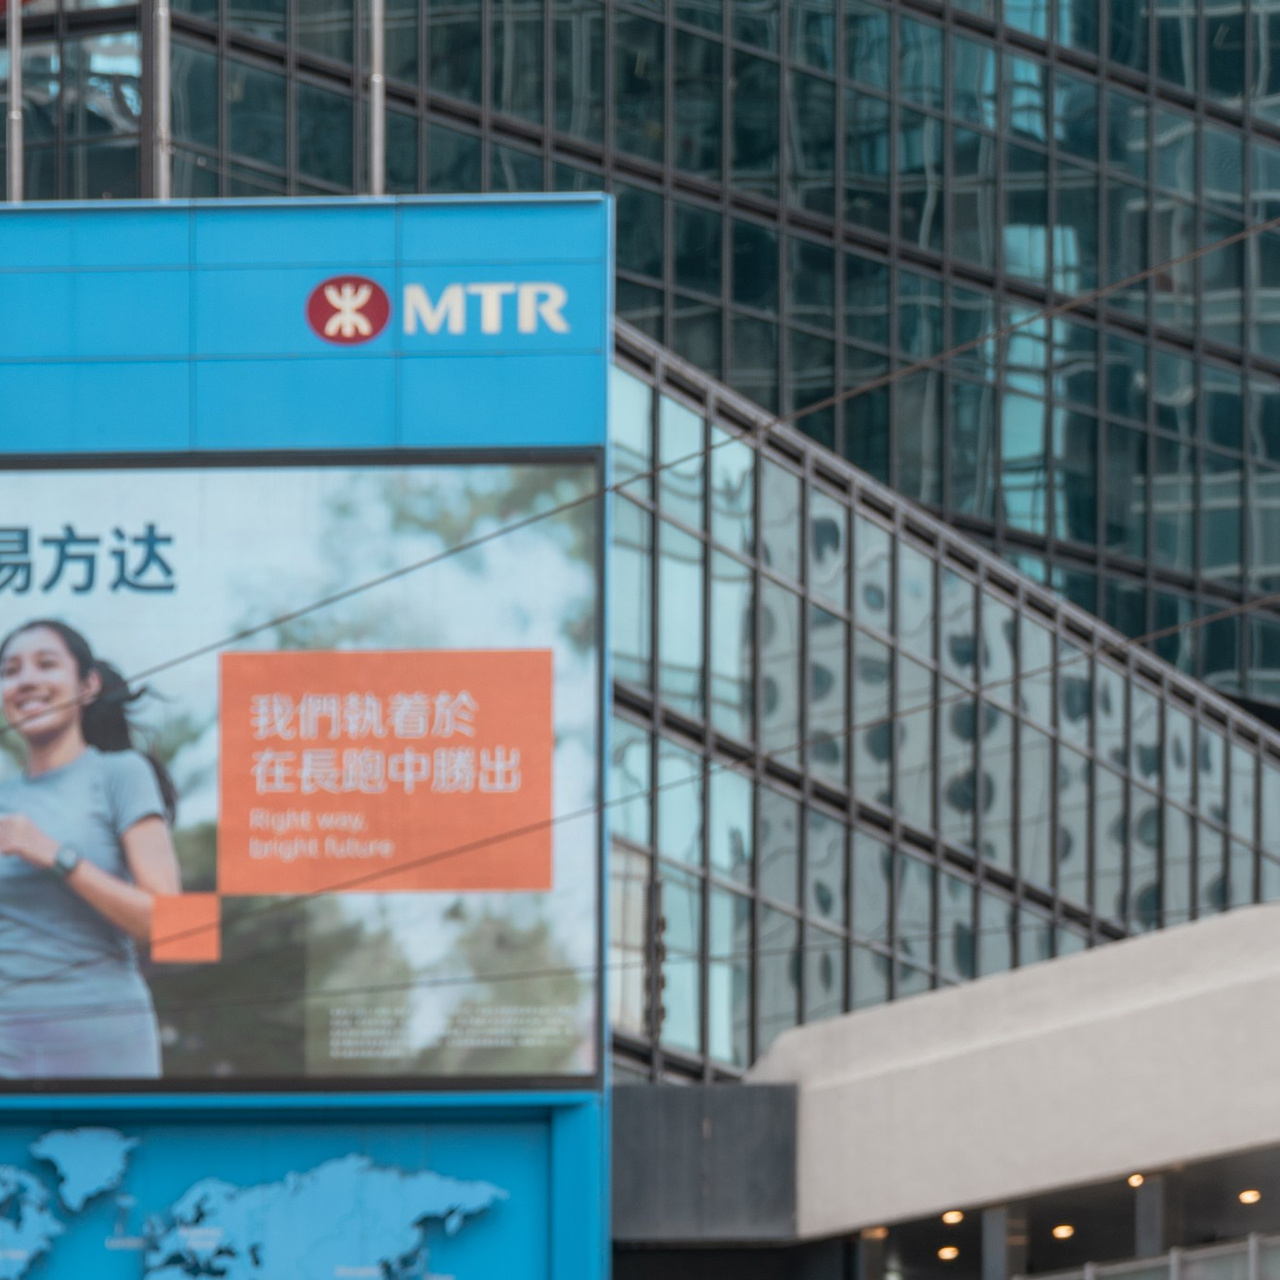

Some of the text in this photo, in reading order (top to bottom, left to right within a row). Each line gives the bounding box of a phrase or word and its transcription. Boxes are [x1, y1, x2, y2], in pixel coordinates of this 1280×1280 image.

[402, 280, 571, 335] MTR
[251, 745, 522, 794] 在長跑中勝出
[249, 807, 312, 834] Right
[249, 836, 396, 863] bright future
